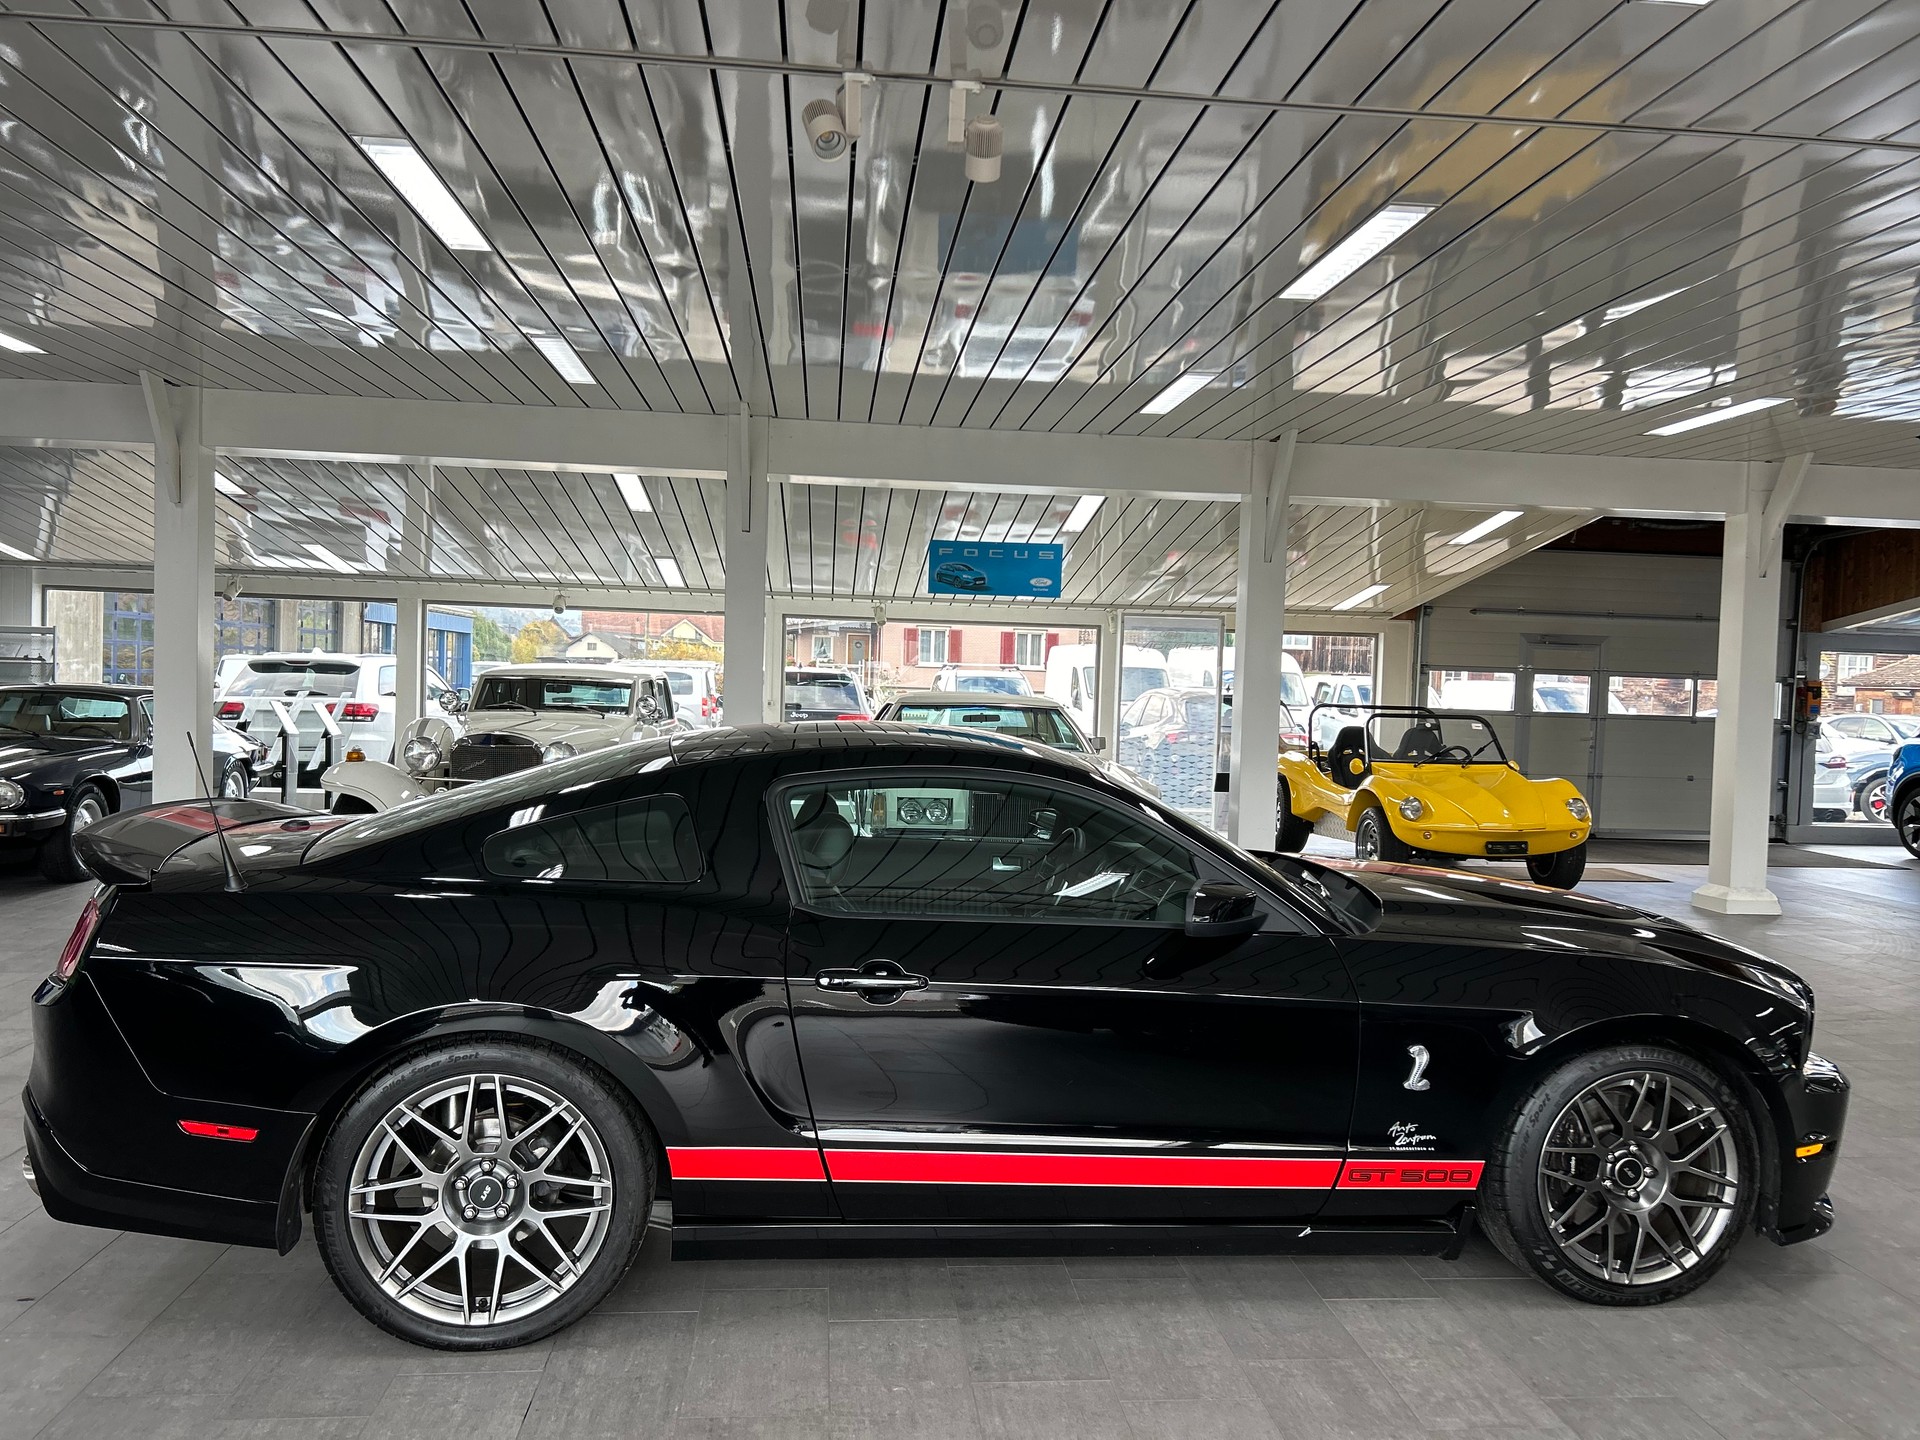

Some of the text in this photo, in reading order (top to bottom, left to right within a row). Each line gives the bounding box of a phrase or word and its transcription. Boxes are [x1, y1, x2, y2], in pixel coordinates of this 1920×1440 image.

[938, 547, 1055, 560] FOCUS
[789, 711, 809, 719] Jeep
[410, 1059, 442, 1077] Super
[447, 1051, 481, 1064] Sport
[1529, 1092, 1551, 1128] Sport
[1348, 1168, 1473, 1183] GT 500
